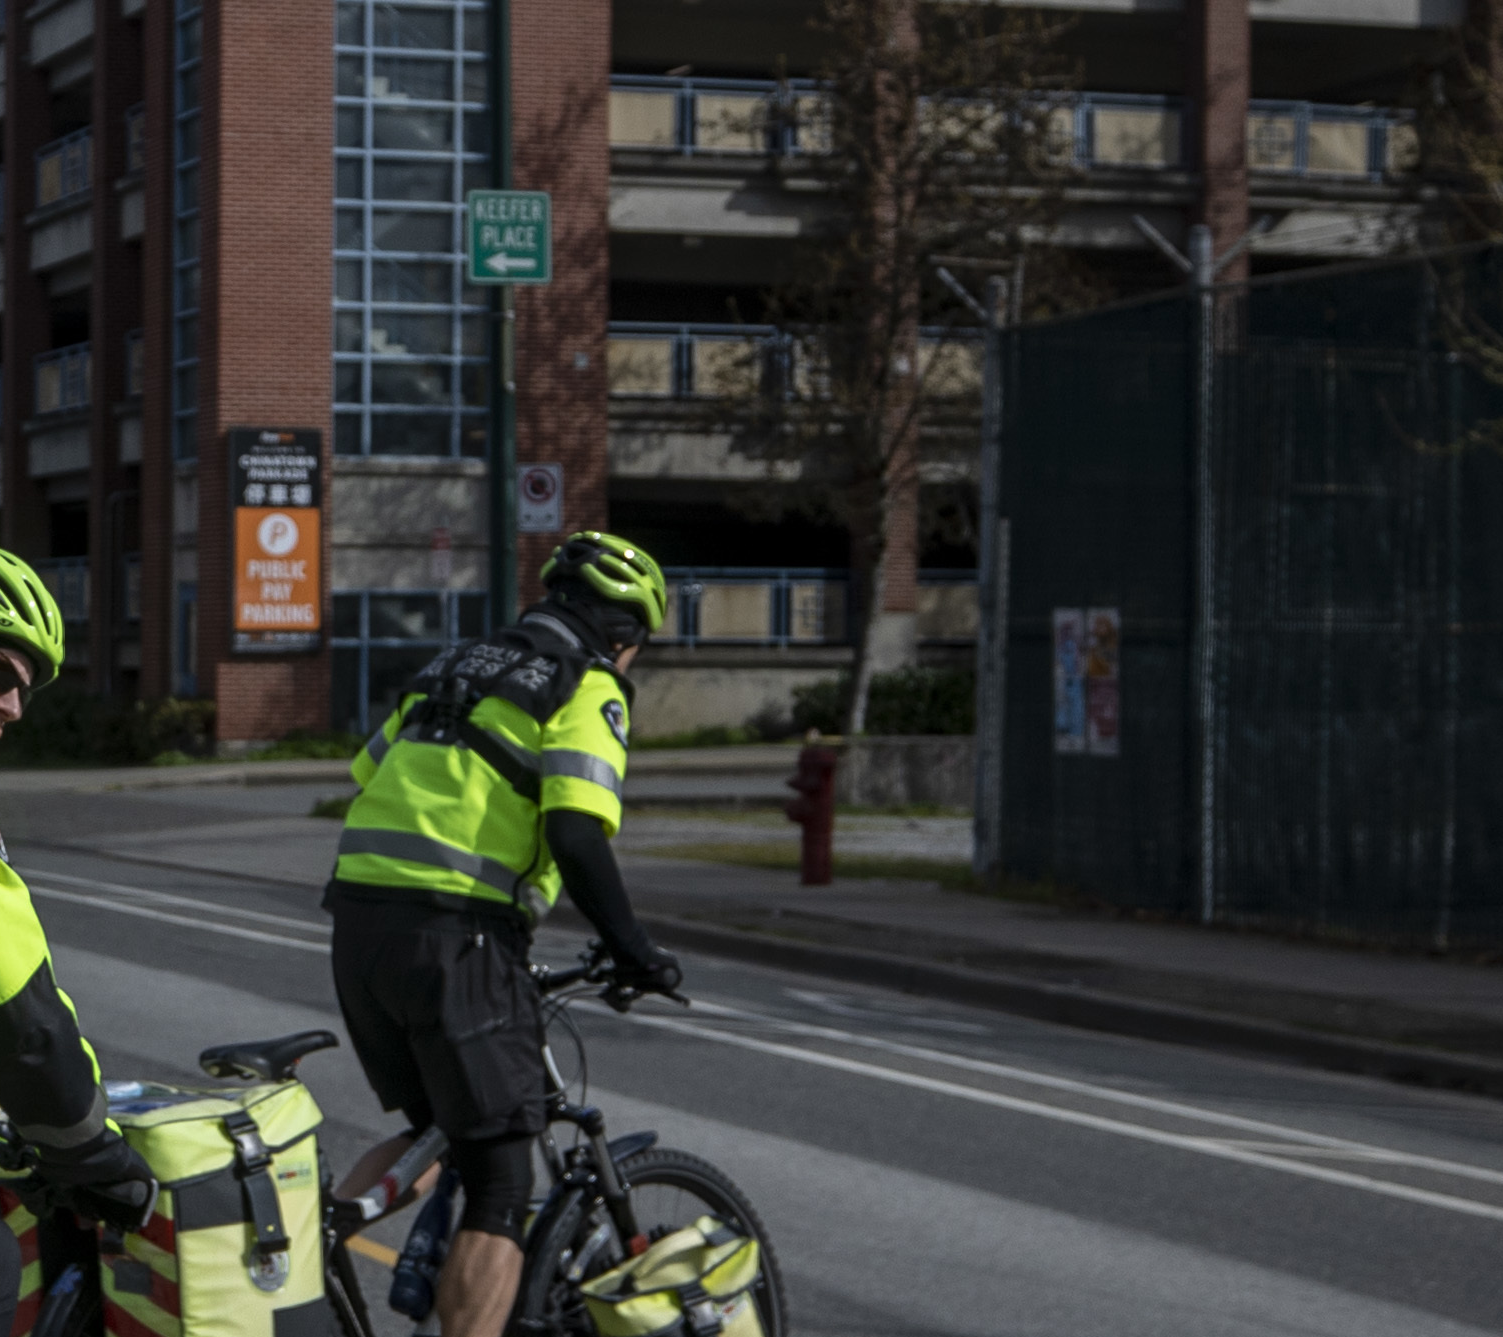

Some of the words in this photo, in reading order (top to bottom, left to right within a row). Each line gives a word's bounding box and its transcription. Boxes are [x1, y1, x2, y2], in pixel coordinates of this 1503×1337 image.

[475, 199, 543, 221] KEEFER
[480, 225, 537, 249] PLACE
[238, 454, 318, 468] CHINATOWN
[246, 559, 307, 580] PUBLIC
[260, 581, 293, 602] PAY
[240, 602, 315, 624] PARKING
